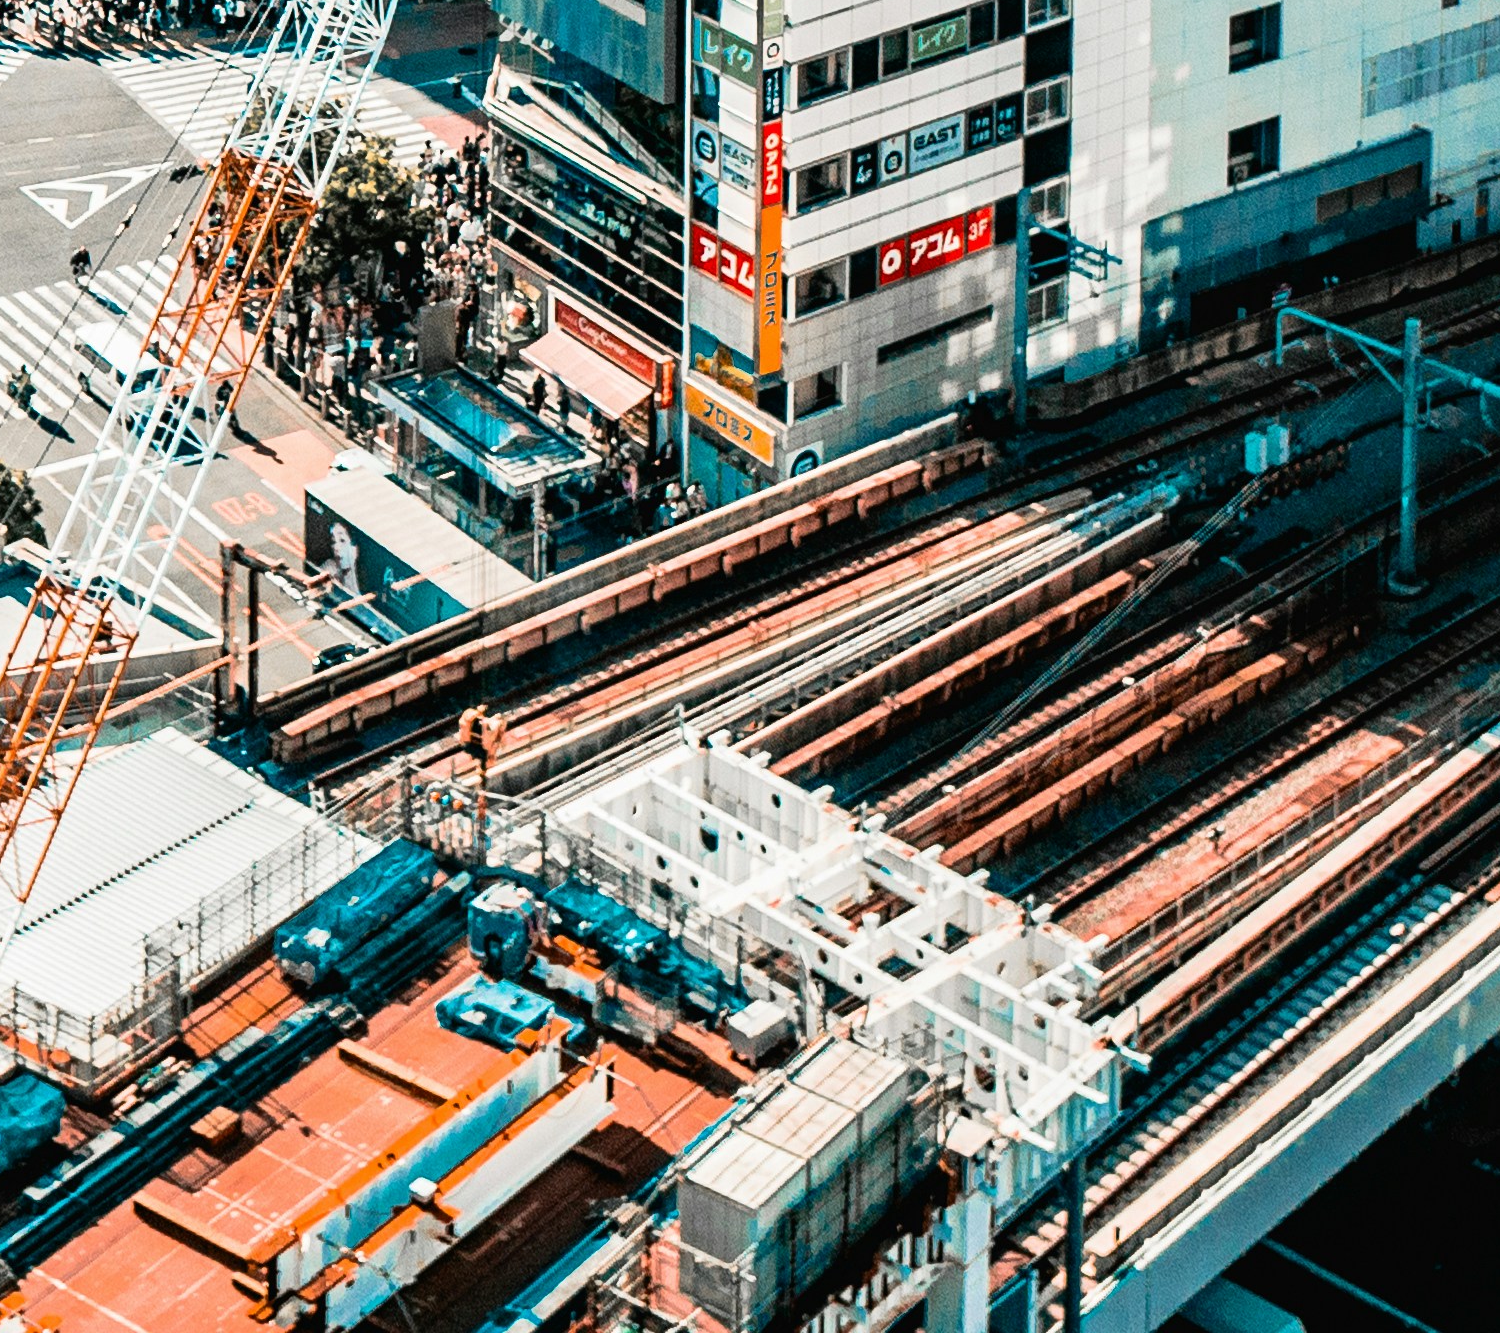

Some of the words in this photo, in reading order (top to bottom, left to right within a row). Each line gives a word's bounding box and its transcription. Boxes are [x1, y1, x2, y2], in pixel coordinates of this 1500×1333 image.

[702, 23, 756, 75] レイク
[918, 23, 959, 55] レイク
[912, 123, 963, 150] EAST
[763, 147, 781, 198] アコム
[698, 232, 757, 296] アコム
[910, 223, 962, 265] アコム
[968, 216, 990, 242] 3F
[763, 249, 780, 329] プロミス
[700, 397, 758, 447] プロミス
